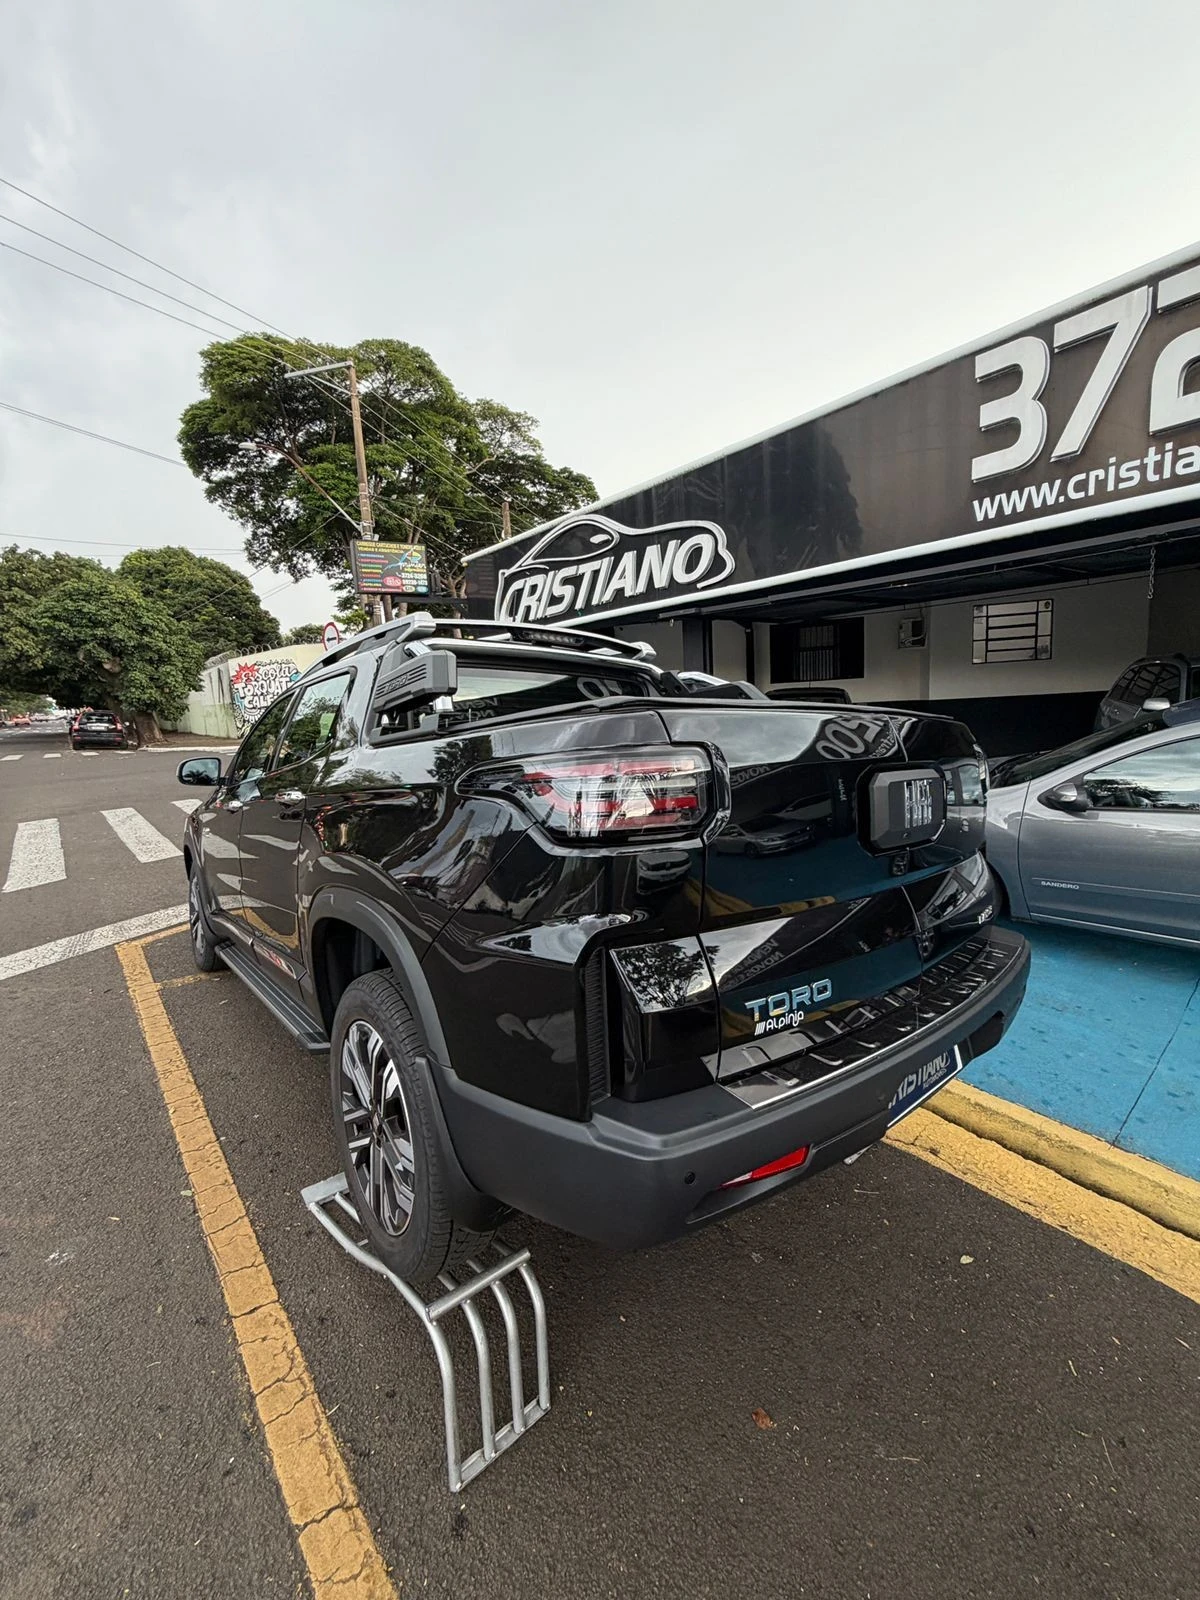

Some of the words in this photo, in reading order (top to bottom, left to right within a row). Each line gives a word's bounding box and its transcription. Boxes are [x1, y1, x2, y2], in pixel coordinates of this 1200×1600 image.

[500, 534, 716, 623] CRISTIANO
[1041, 880, 1080, 890] SANDERO
[744, 978, 832, 1021] TORO
